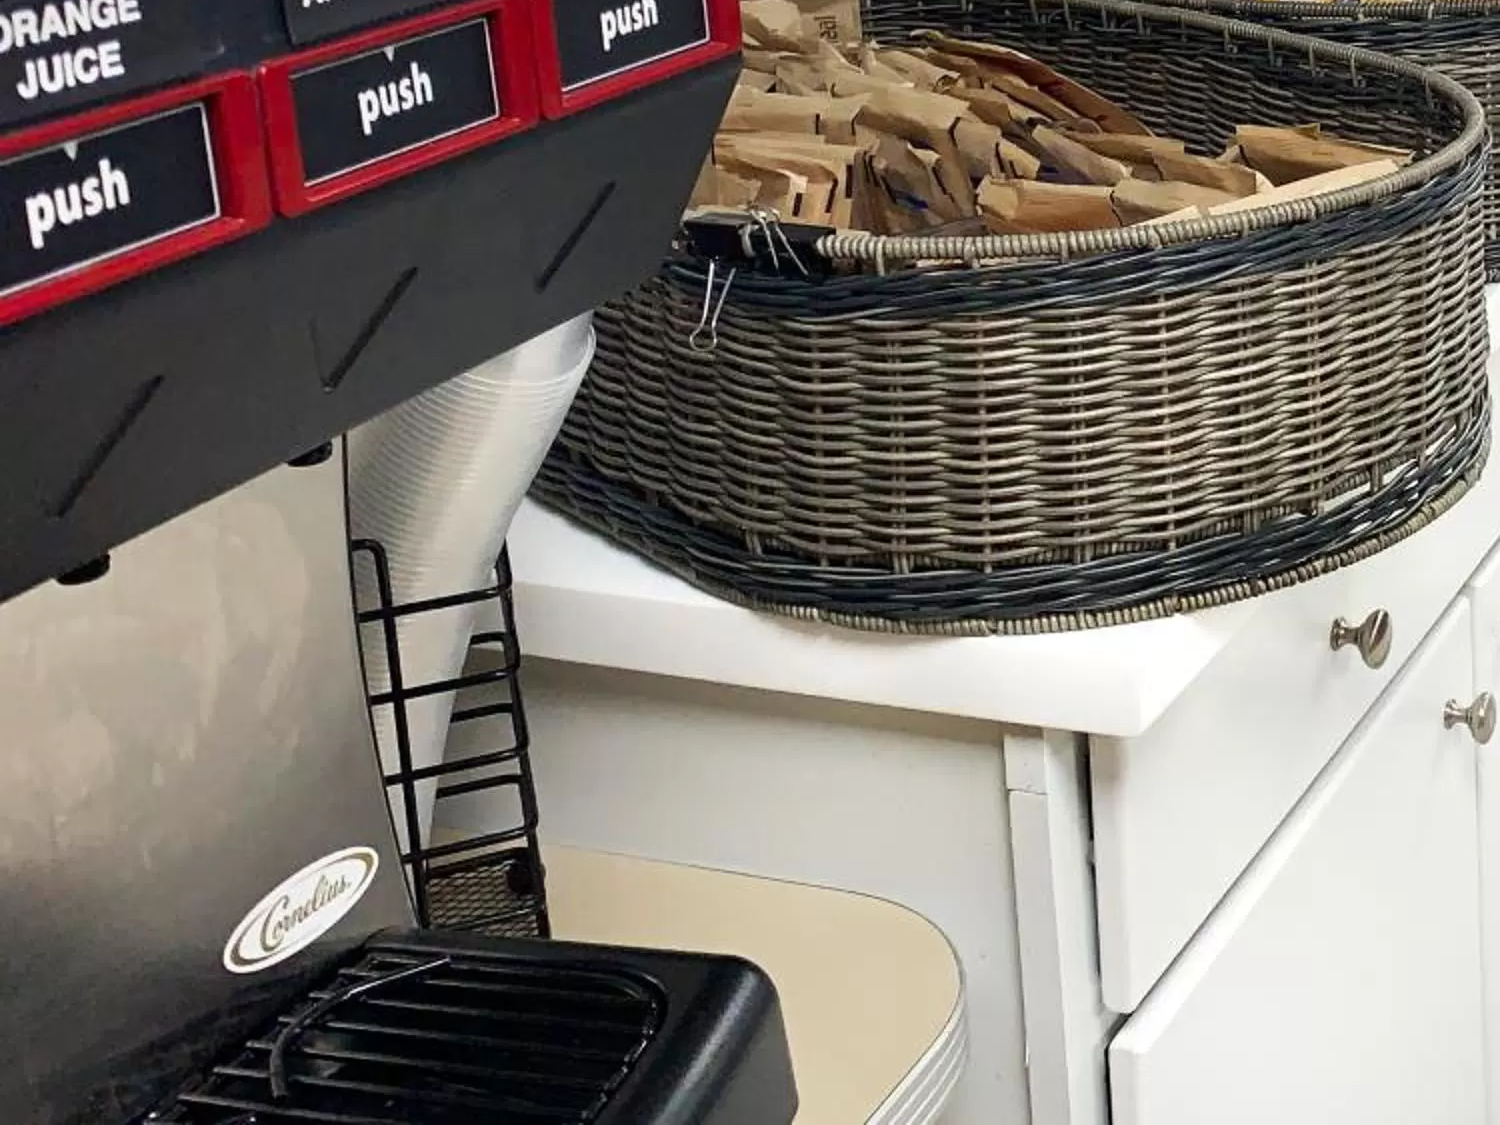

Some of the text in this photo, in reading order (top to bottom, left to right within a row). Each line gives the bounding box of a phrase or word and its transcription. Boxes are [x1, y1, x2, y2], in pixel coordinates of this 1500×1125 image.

[16, 39, 126, 100] JUICE
[357, 62, 433, 135] push
[25, 158, 130, 249] push
